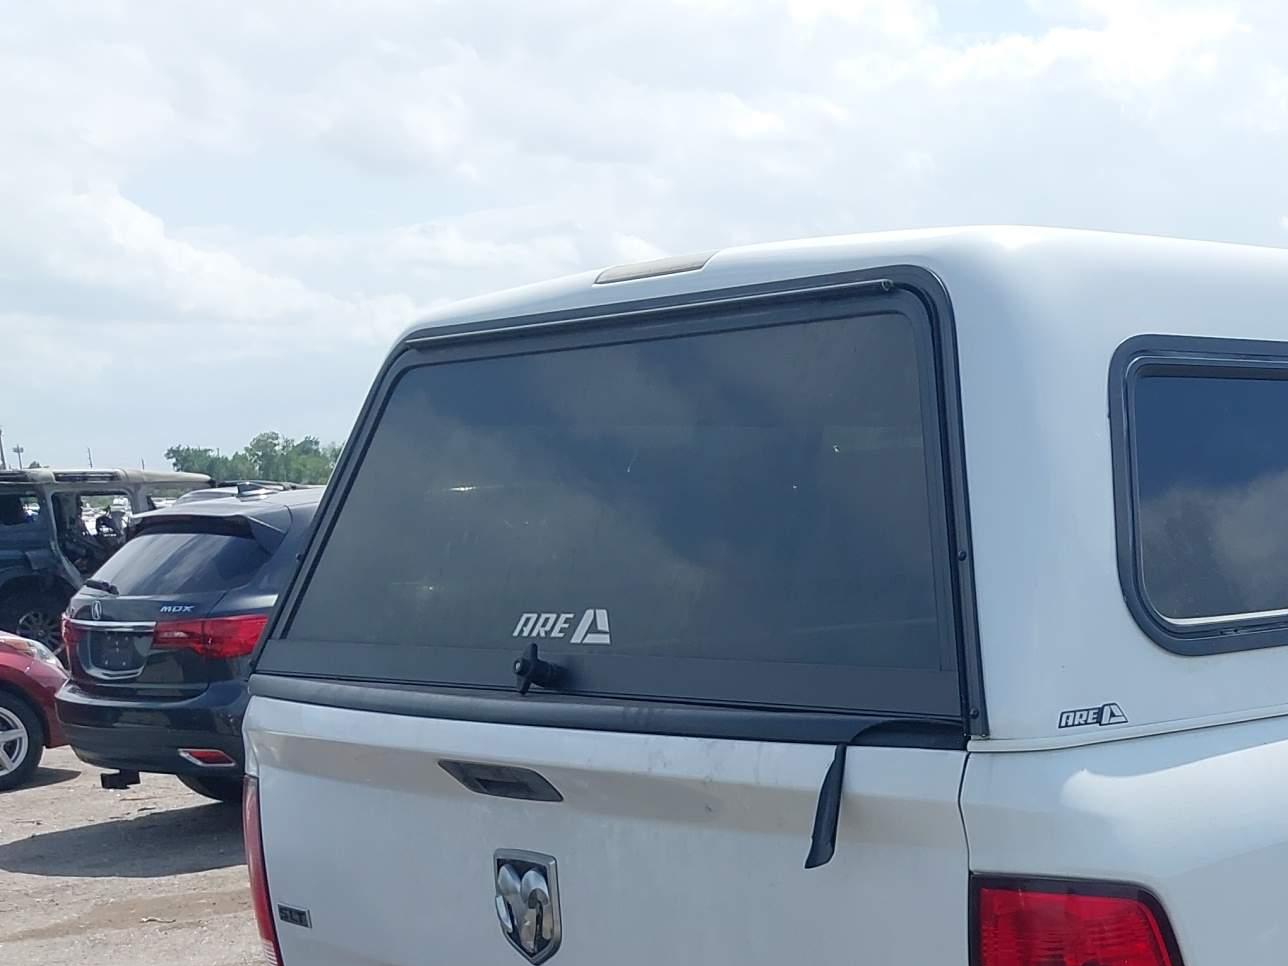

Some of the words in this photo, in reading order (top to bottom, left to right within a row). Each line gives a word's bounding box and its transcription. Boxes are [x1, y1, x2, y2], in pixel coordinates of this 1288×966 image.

[160, 605, 195, 613] MDX
[512, 612, 575, 638] ARE
[1060, 709, 1099, 727] ARE
